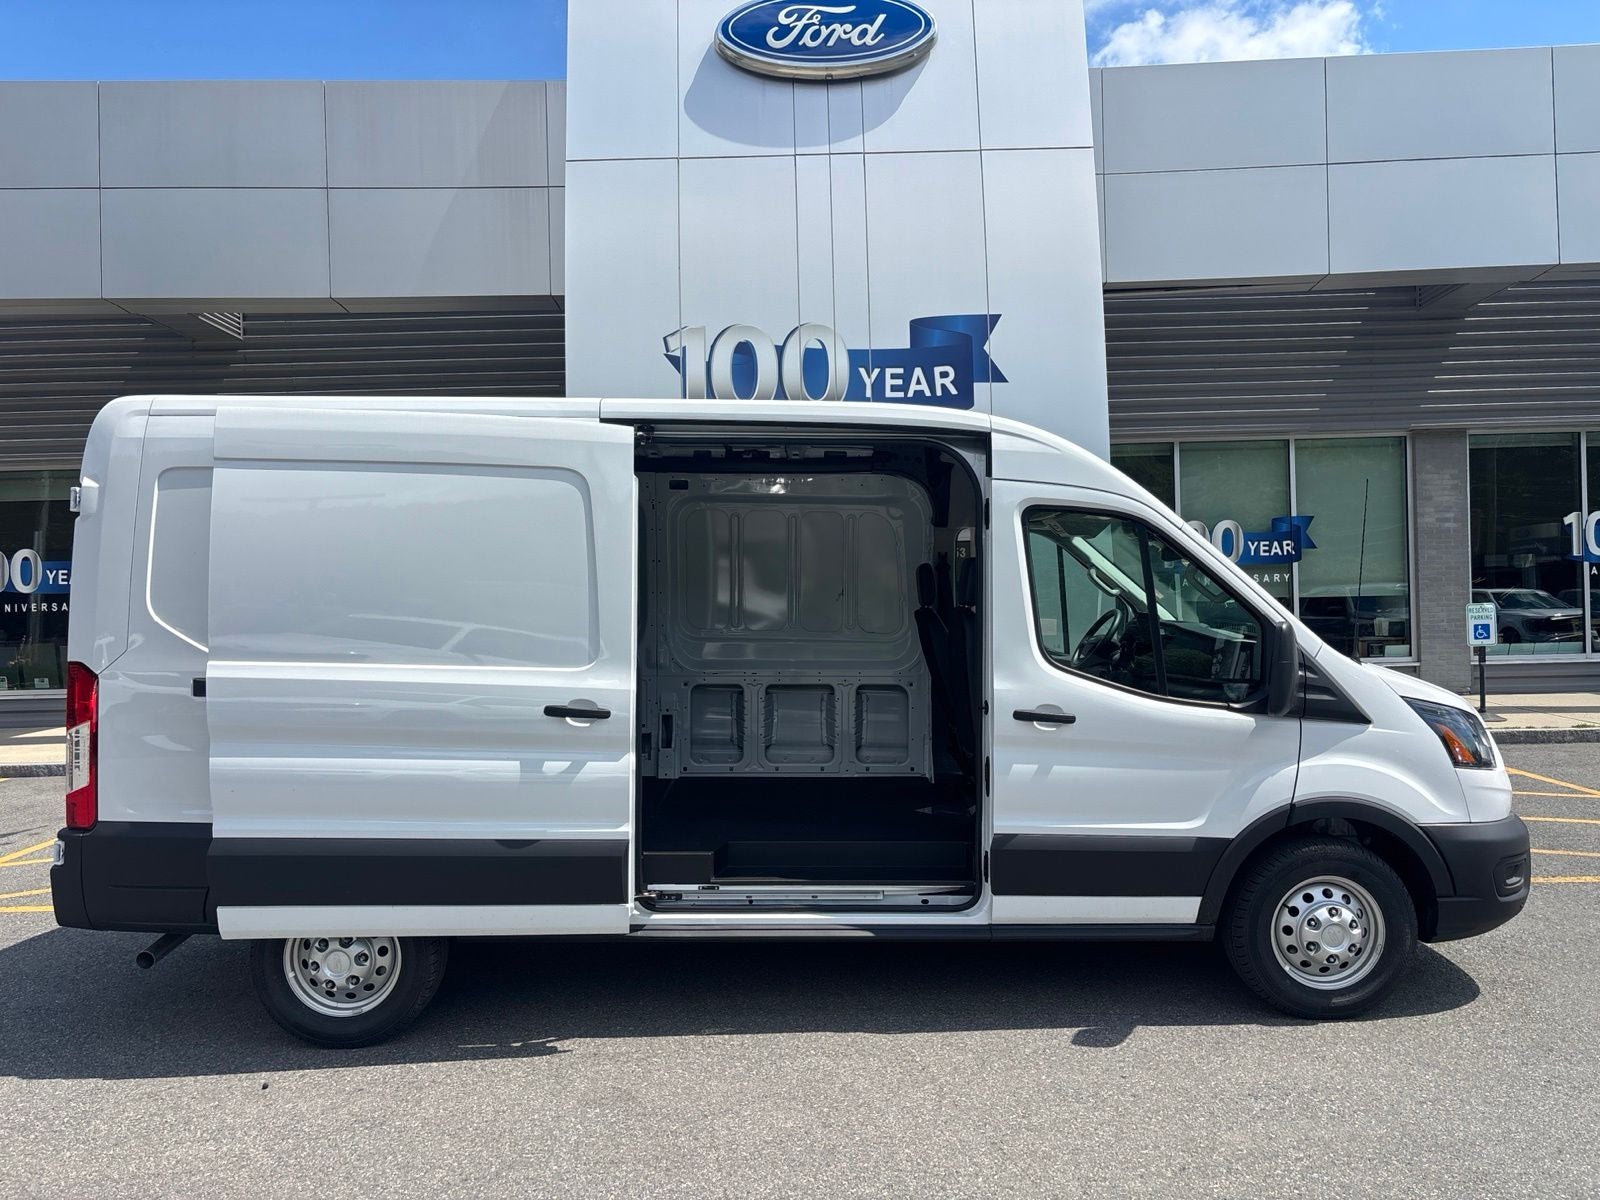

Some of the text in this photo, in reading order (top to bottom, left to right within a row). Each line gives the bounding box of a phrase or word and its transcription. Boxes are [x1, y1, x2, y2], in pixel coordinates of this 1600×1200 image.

[766, 5, 887, 48] Ford
[663, 323, 958, 400] 100 YEAR
[1248, 540, 1295, 556] YEAR
[46, 569, 72, 585] YE
